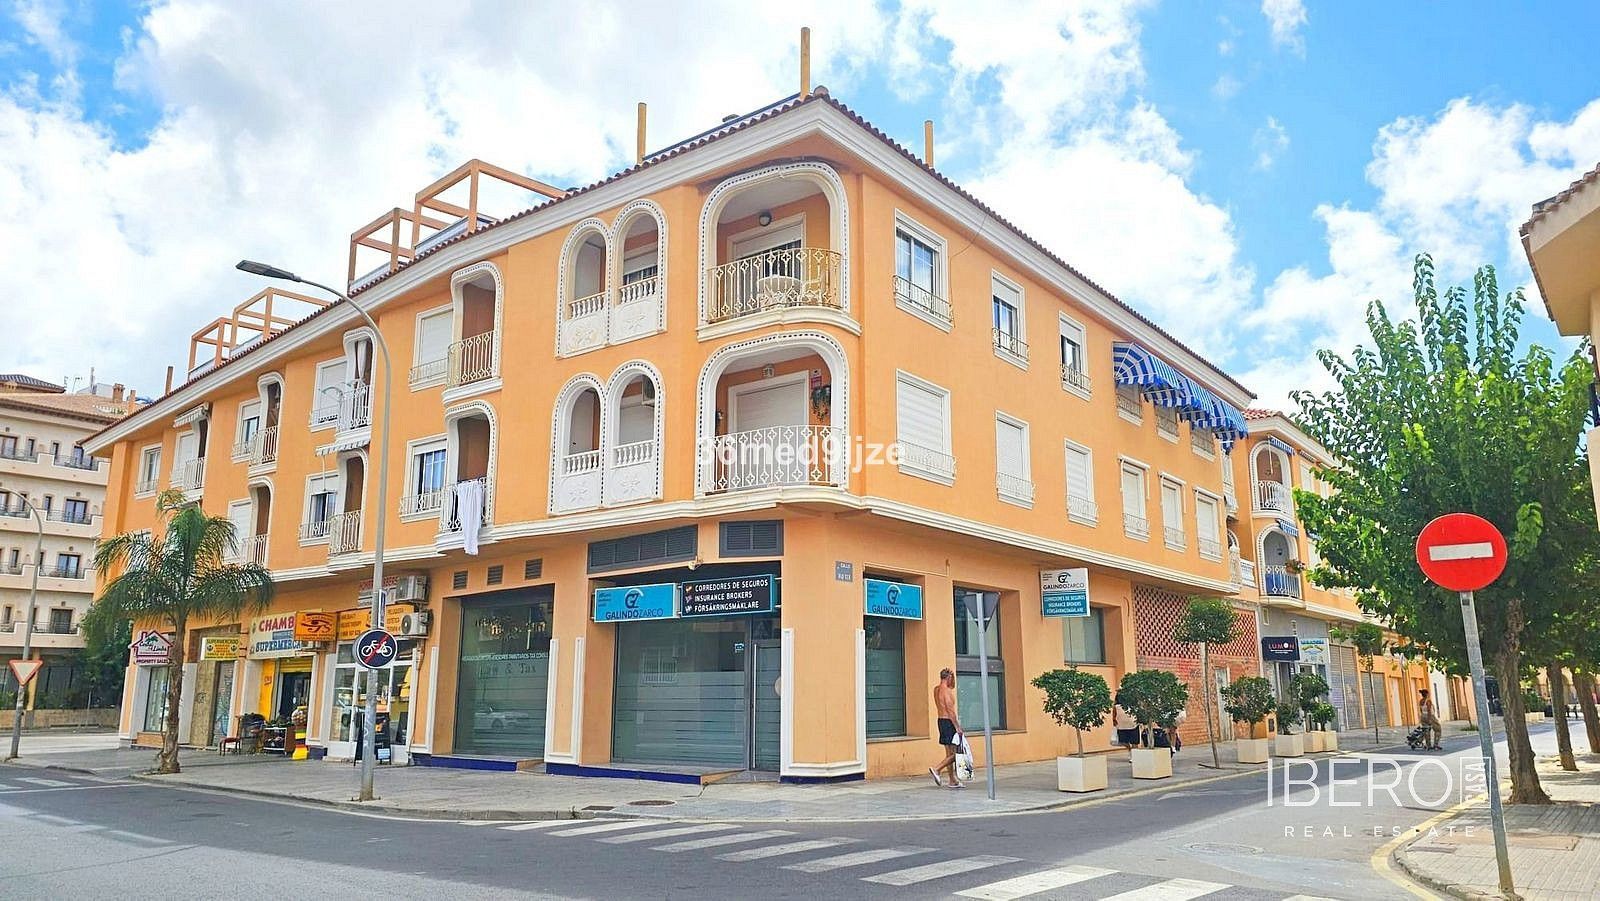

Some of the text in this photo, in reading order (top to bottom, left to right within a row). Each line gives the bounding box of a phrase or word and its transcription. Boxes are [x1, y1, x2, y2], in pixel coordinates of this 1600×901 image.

[695, 579, 769, 592] CORREDORES DE SEGUROS
[694, 591, 753, 602] INSURANCE BROKERS
[605, 608, 664, 620] GALINDOZARCO
[1268, 642, 1295, 650] LUMON
